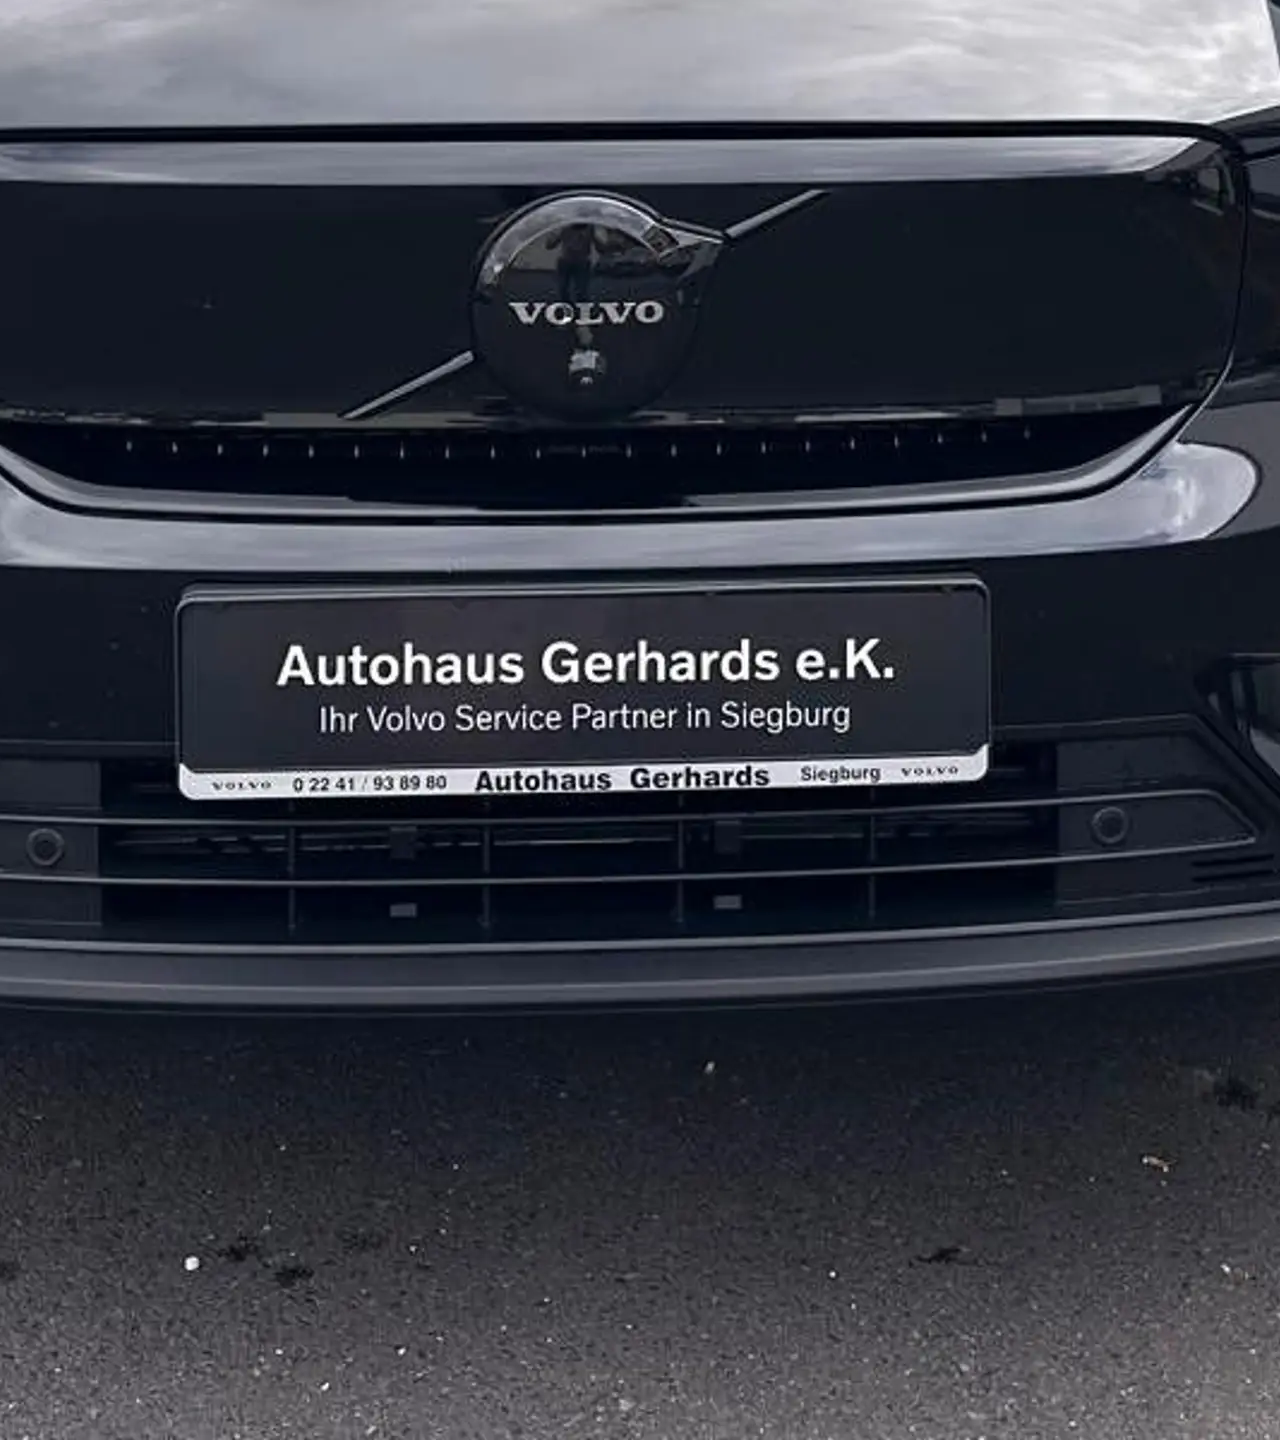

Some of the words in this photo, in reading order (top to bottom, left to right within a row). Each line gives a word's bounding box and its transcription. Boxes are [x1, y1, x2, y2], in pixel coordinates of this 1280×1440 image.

[508, 300, 665, 326] VOLVO
[276, 641, 525, 686] Autohaus
[541, 638, 781, 684] Gerhards
[795, 638, 895, 681] e.K.
[320, 705, 359, 733] Ihr
[366, 704, 446, 732] Volvo
[455, 703, 562, 732] Service
[572, 702, 677, 730] Partner
[687, 701, 711, 729] in
[721, 700, 851, 734] Siegburg
[211, 779, 273, 792] VOLVO
[292, 777, 304, 793] 0
[308, 777, 330, 792] 22
[335, 776, 355, 792] 41
[373, 775, 395, 791] 93
[400, 774, 421, 791] 89
[425, 774, 448, 790] 80
[475, 768, 613, 794] Autohaus
[630, 765, 770, 790] Gerhards
[800, 765, 882, 784] Siegburg
[900, 765, 959, 777] VOLVO
